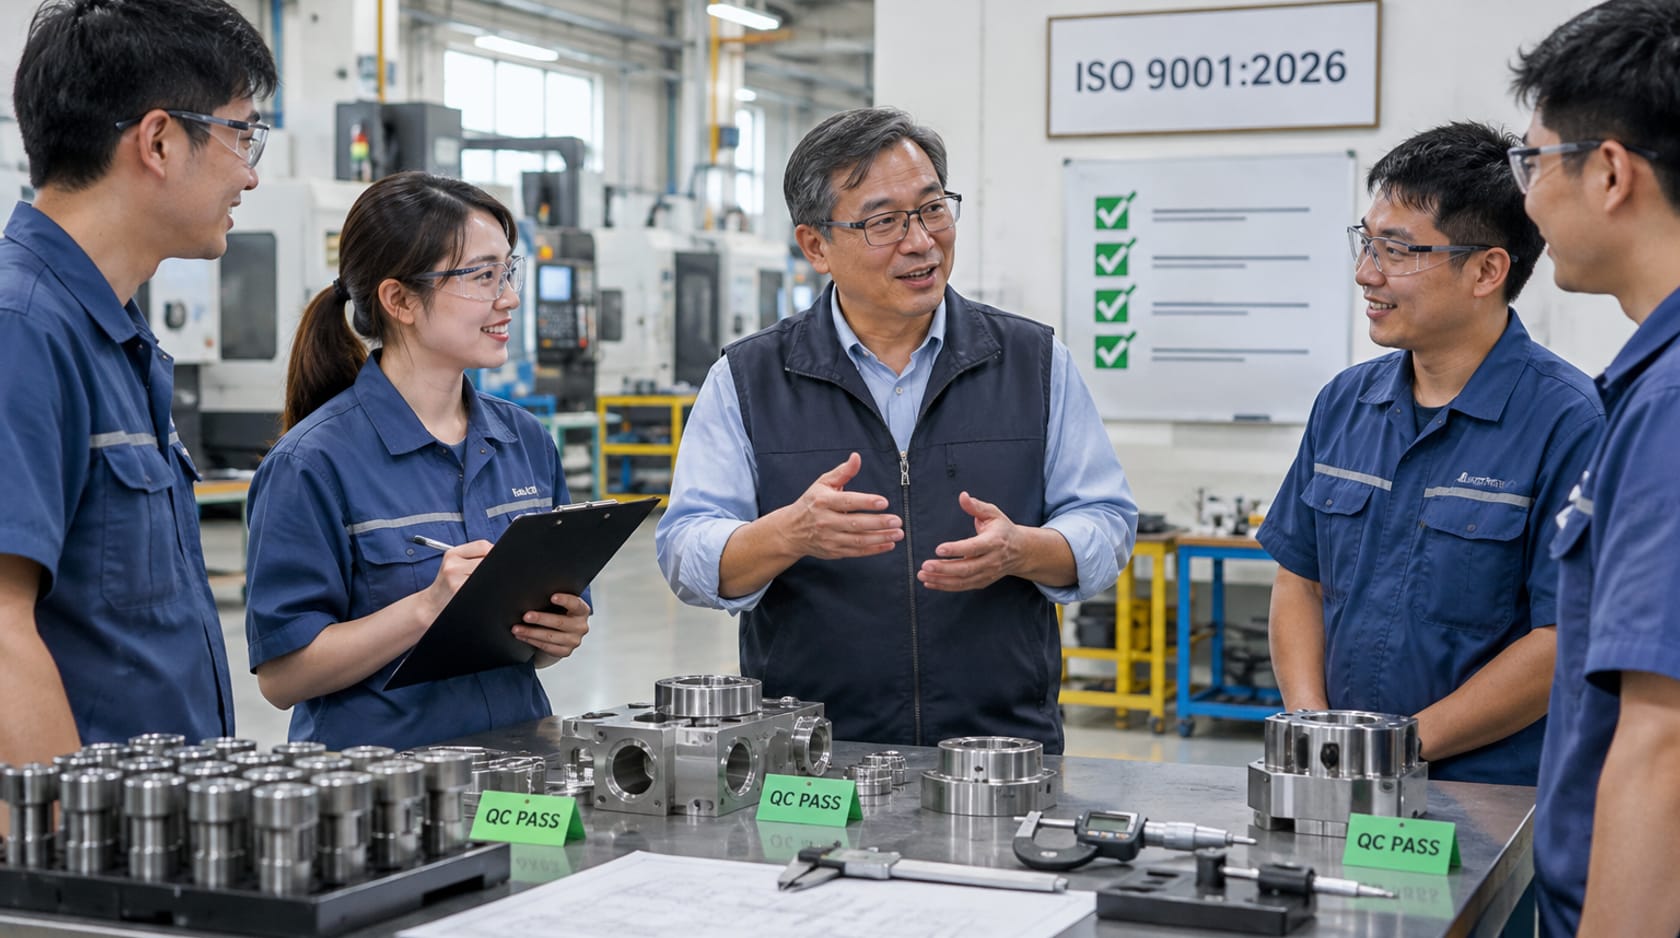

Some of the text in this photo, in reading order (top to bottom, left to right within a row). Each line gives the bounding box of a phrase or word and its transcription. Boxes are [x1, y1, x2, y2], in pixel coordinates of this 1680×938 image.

[1075, 49, 1347, 93] ISO 9001:2026
[770, 789, 842, 811] QC PASS
[486, 808, 561, 829] QC PASS
[1357, 832, 1441, 856] QC PASS
